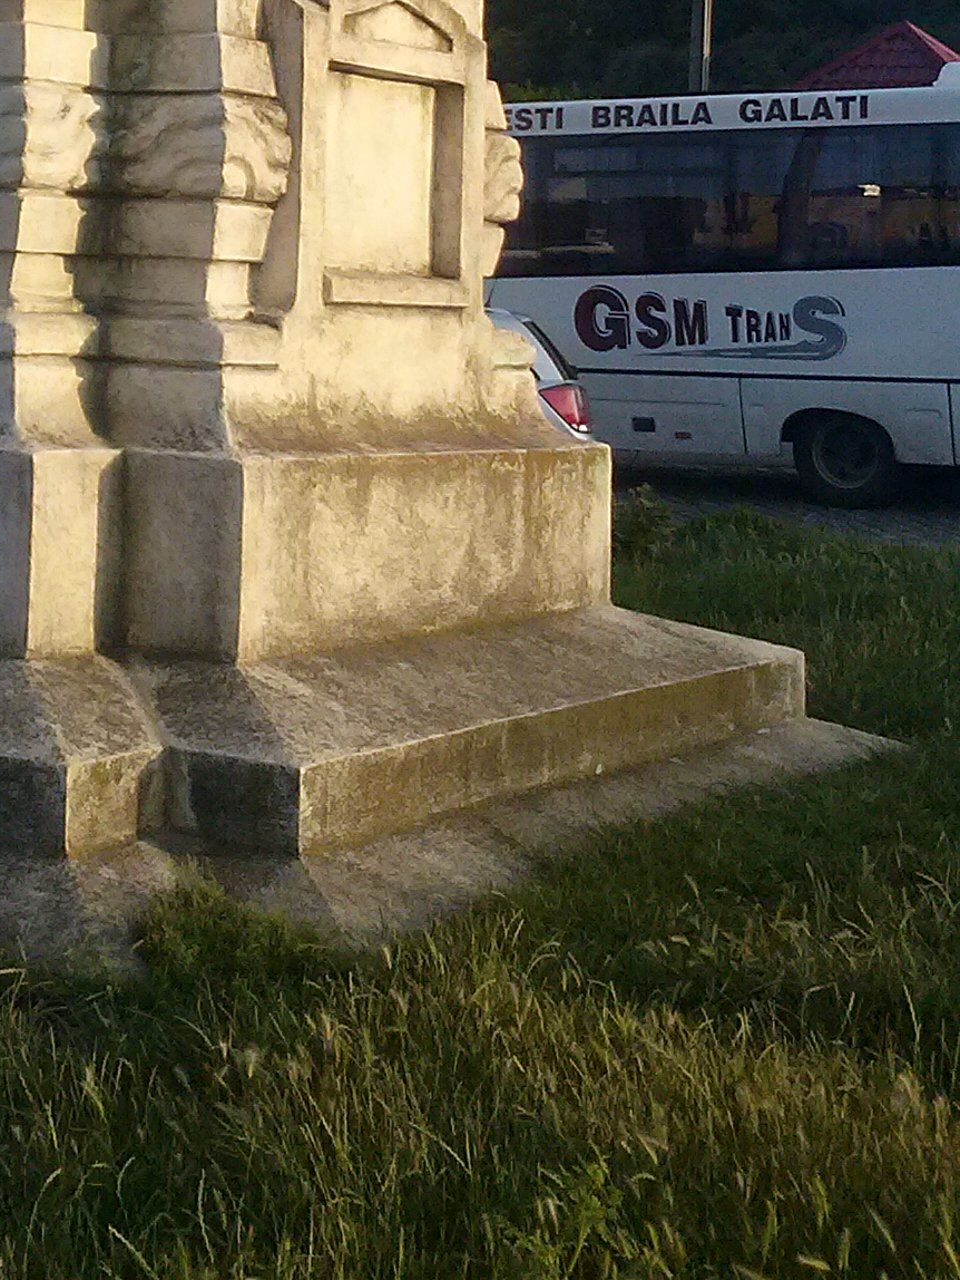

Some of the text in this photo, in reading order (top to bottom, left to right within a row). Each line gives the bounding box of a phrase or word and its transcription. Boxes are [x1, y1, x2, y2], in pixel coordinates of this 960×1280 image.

[591, 101, 713, 129] BRAILA
[738, 94, 870, 123] GALATI
[574, 284, 848, 360] GSM TRANS
